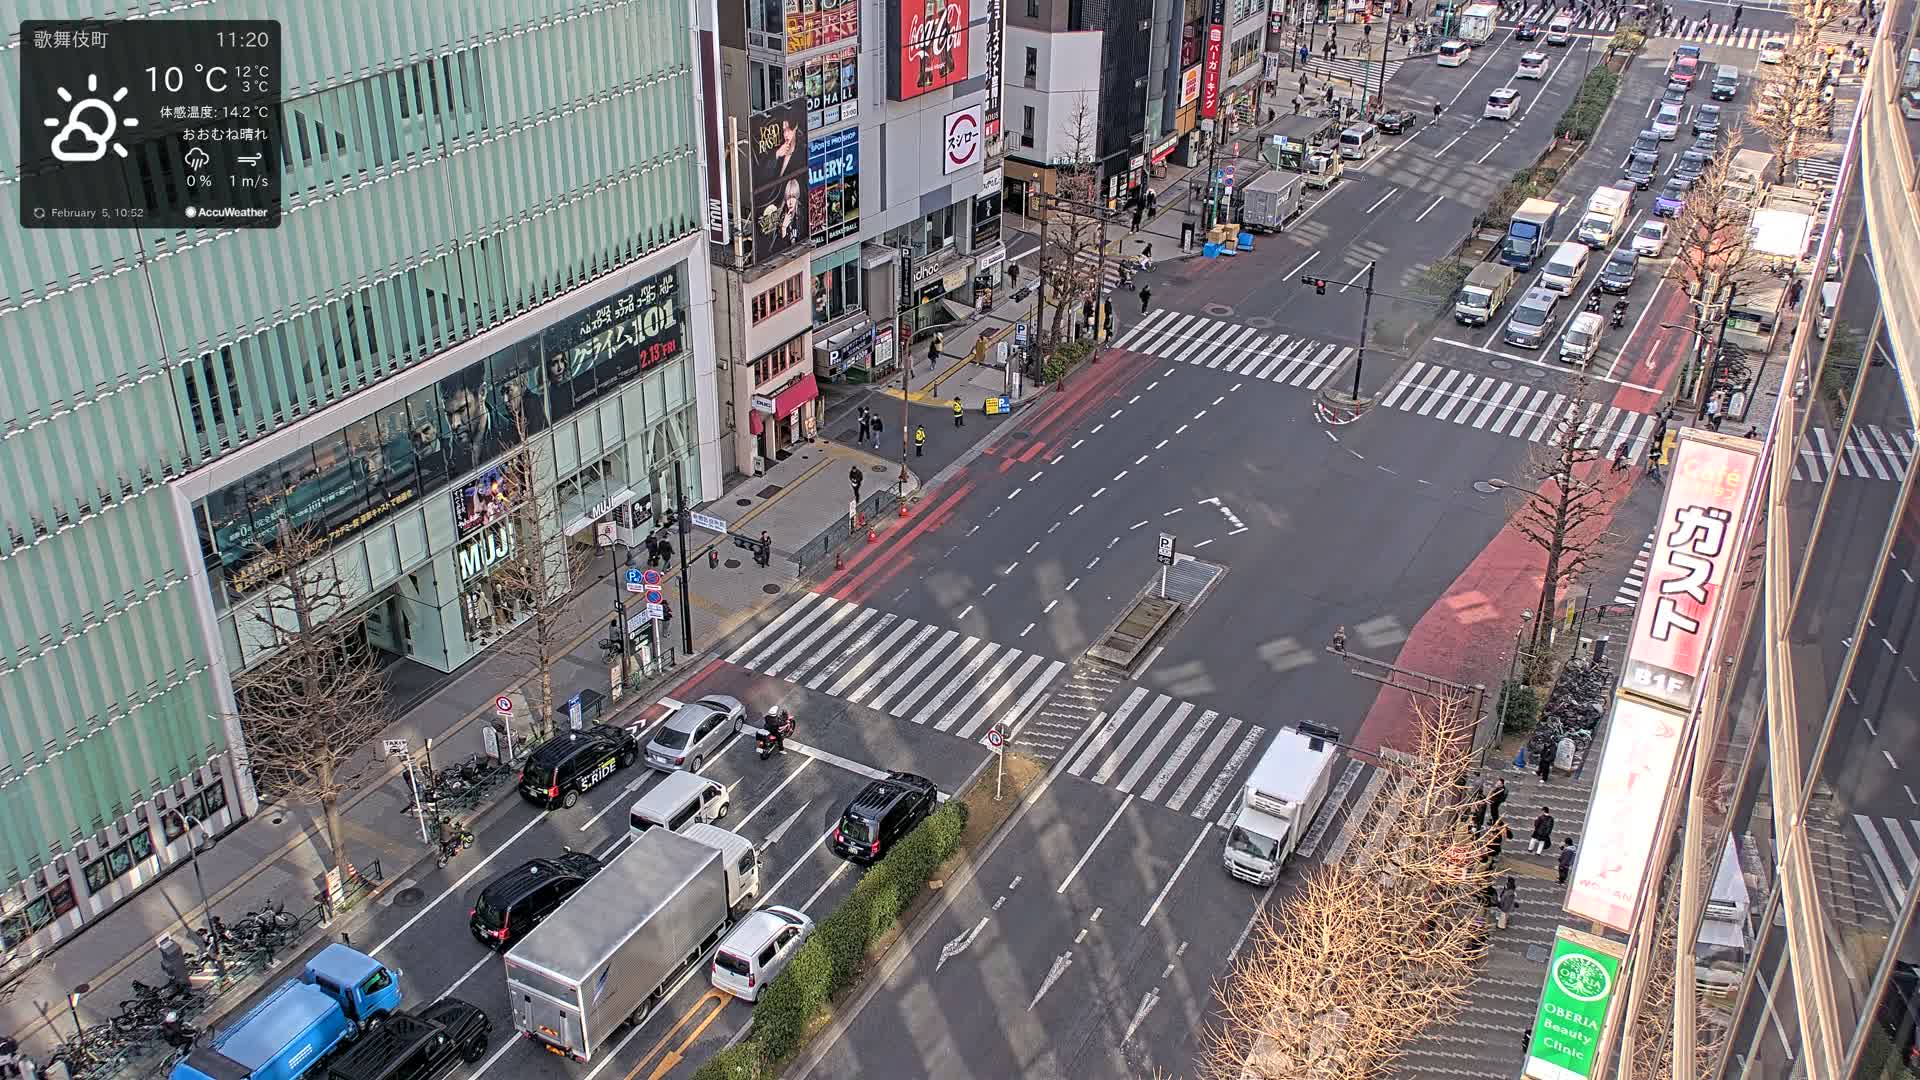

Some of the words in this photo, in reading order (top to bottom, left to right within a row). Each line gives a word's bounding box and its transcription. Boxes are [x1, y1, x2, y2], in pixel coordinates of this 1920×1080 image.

[1205, 44, 1220, 109] バーガーキング
[947, 131, 979, 151] スシロー
[710, 198, 722, 232] MUJI
[902, 249, 910, 258] P
[596, 305, 611, 318] クリス
[615, 304, 634, 319] ラファロ
[618, 294, 633, 306] マーク
[1018, 325, 1025, 334] P
[640, 343, 660, 369] 2.13
[663, 339, 676, 357] FRI
[830, 351, 839, 366] P
[592, 496, 615, 519] MUJI
[459, 521, 515, 581] MUJI
[1650, 505, 1732, 641] ガスト
[1633, 667, 1685, 695] B1F
[581, 761, 616, 792] S.RIDE
[1544, 1003, 1598, 1031] OBERIA
[1544, 1019, 1592, 1045] Beauty
[1543, 1037, 1584, 1060] Clinic
